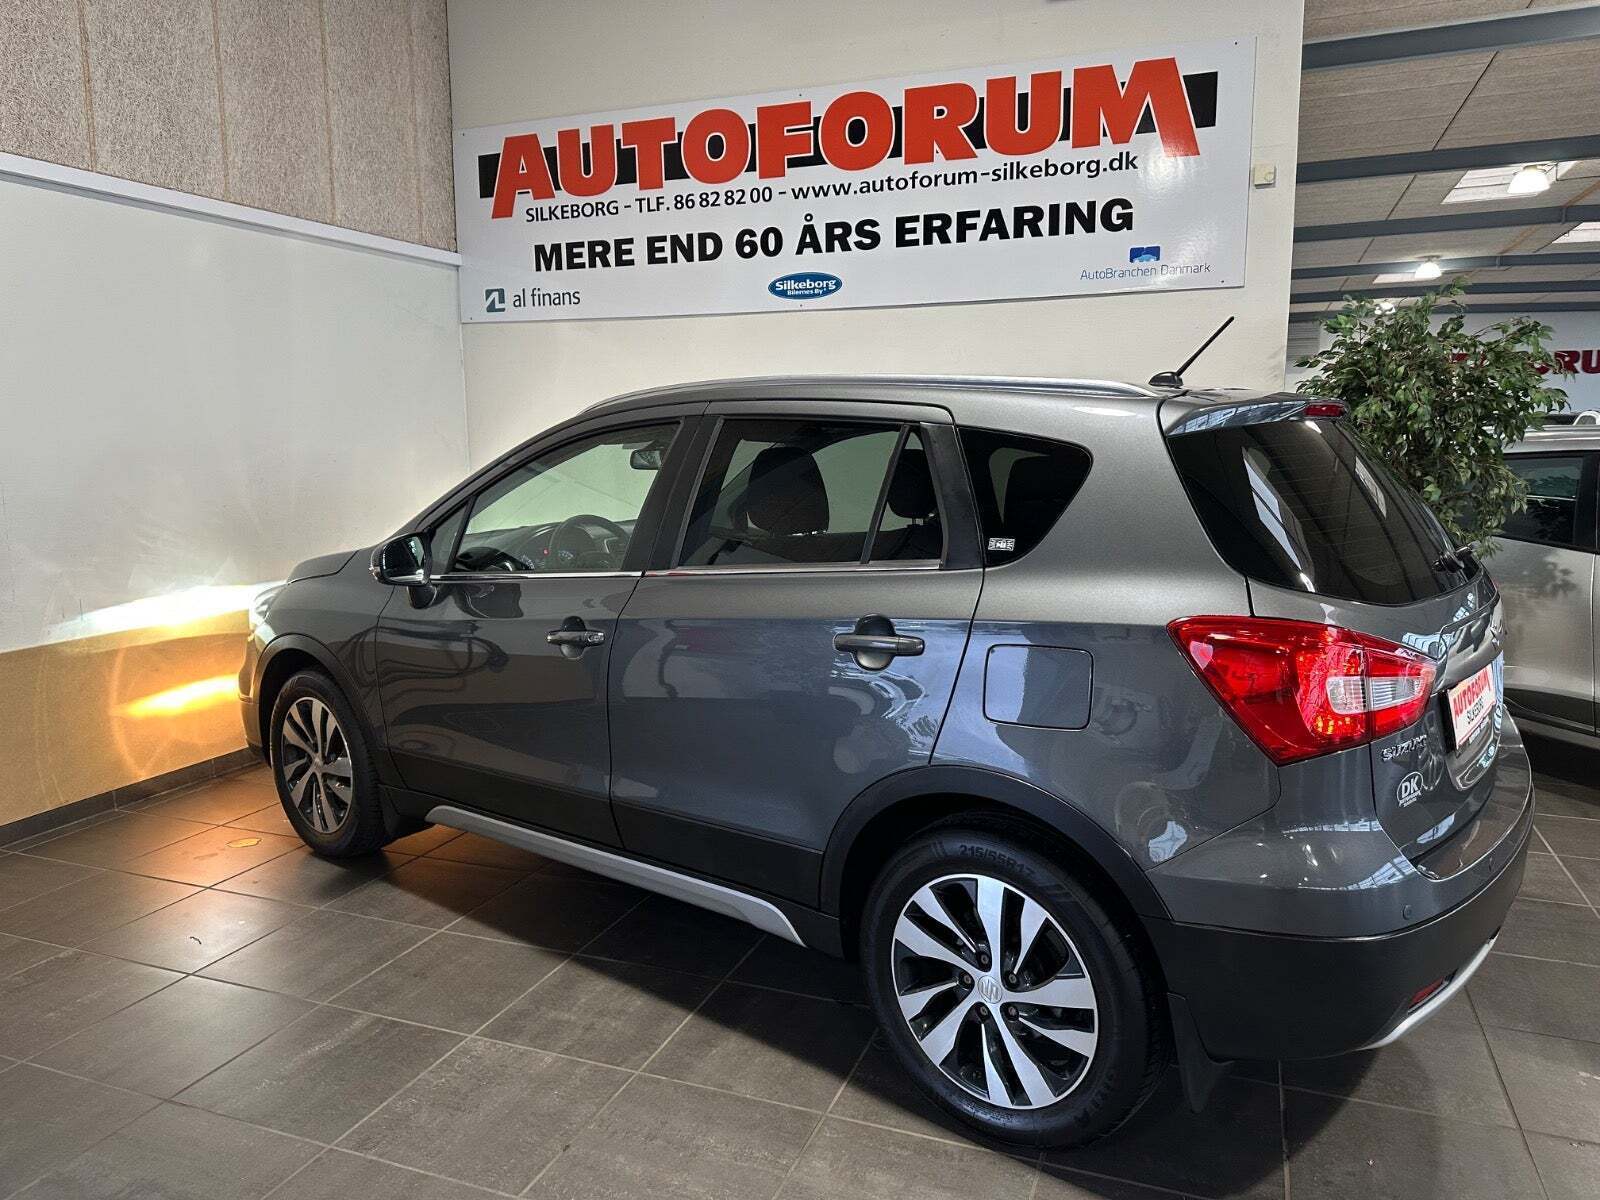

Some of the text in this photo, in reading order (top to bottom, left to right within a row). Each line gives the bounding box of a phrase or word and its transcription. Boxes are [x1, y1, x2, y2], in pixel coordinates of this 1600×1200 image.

[490, 56, 1200, 220] AUTOFORUM
[525, 200, 620, 223] SILKEBORG
[635, 196, 671, 213] TLF.
[792, 151, 1139, 200] www.autoforum-silkeborg.dk
[534, 197, 1134, 273] MERE END 60 ÅRS ERFARING
[1080, 261, 1212, 281] AutoBranchen Danmark
[775, 278, 837, 291] Silkeborg
[512, 287, 581, 308] al finans
[1401, 775, 1420, 799] DK
